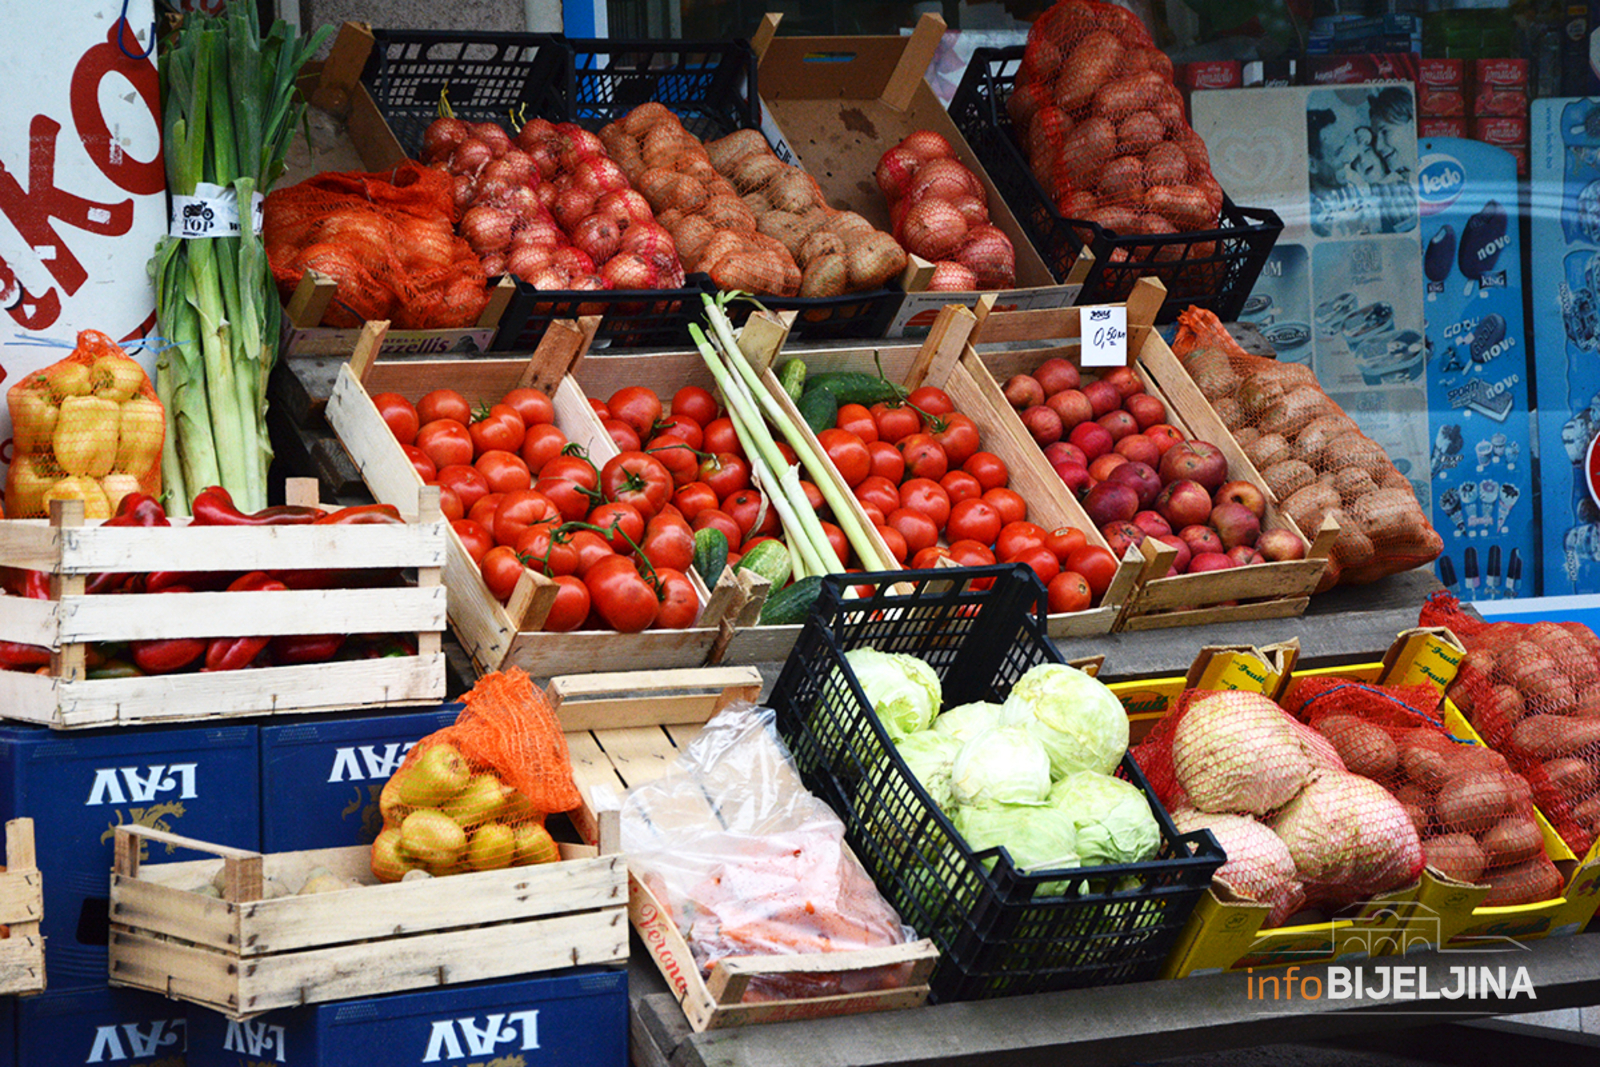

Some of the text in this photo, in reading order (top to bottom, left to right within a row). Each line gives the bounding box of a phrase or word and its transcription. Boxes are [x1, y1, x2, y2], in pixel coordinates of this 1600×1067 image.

[183, 219, 214, 232] TOP
[1481, 275, 1505, 287] KING
[380, 336, 450, 354] zzellis
[85, 762, 199, 806] LAV
[639, 903, 689, 995] Verona
[223, 1018, 286, 1063] LAV
[421, 1009, 541, 1063] LAV
